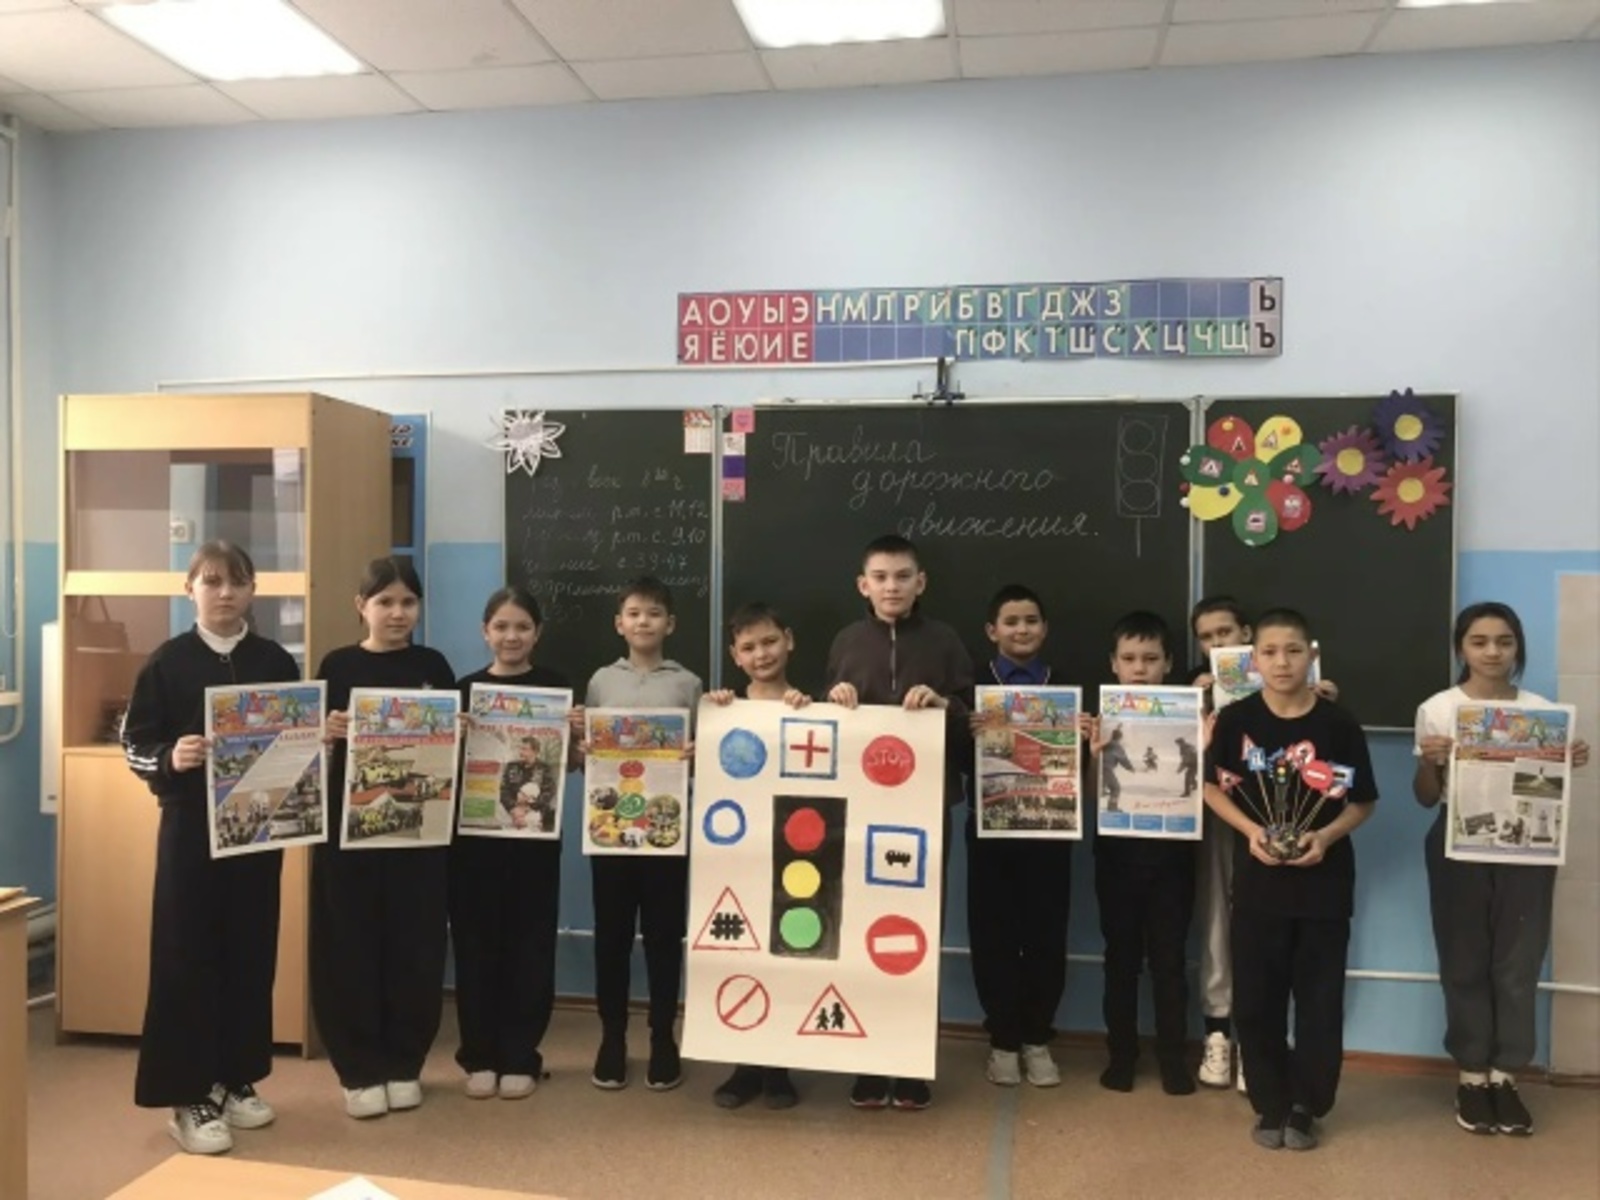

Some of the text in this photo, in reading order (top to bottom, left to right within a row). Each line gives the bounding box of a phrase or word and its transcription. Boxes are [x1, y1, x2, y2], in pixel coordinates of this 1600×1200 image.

[772, 424, 937, 480] Правила
[850, 469, 1056, 511] дорожного
[897, 501, 1099, 541] движения.
[866, 749, 911, 768] STOP
